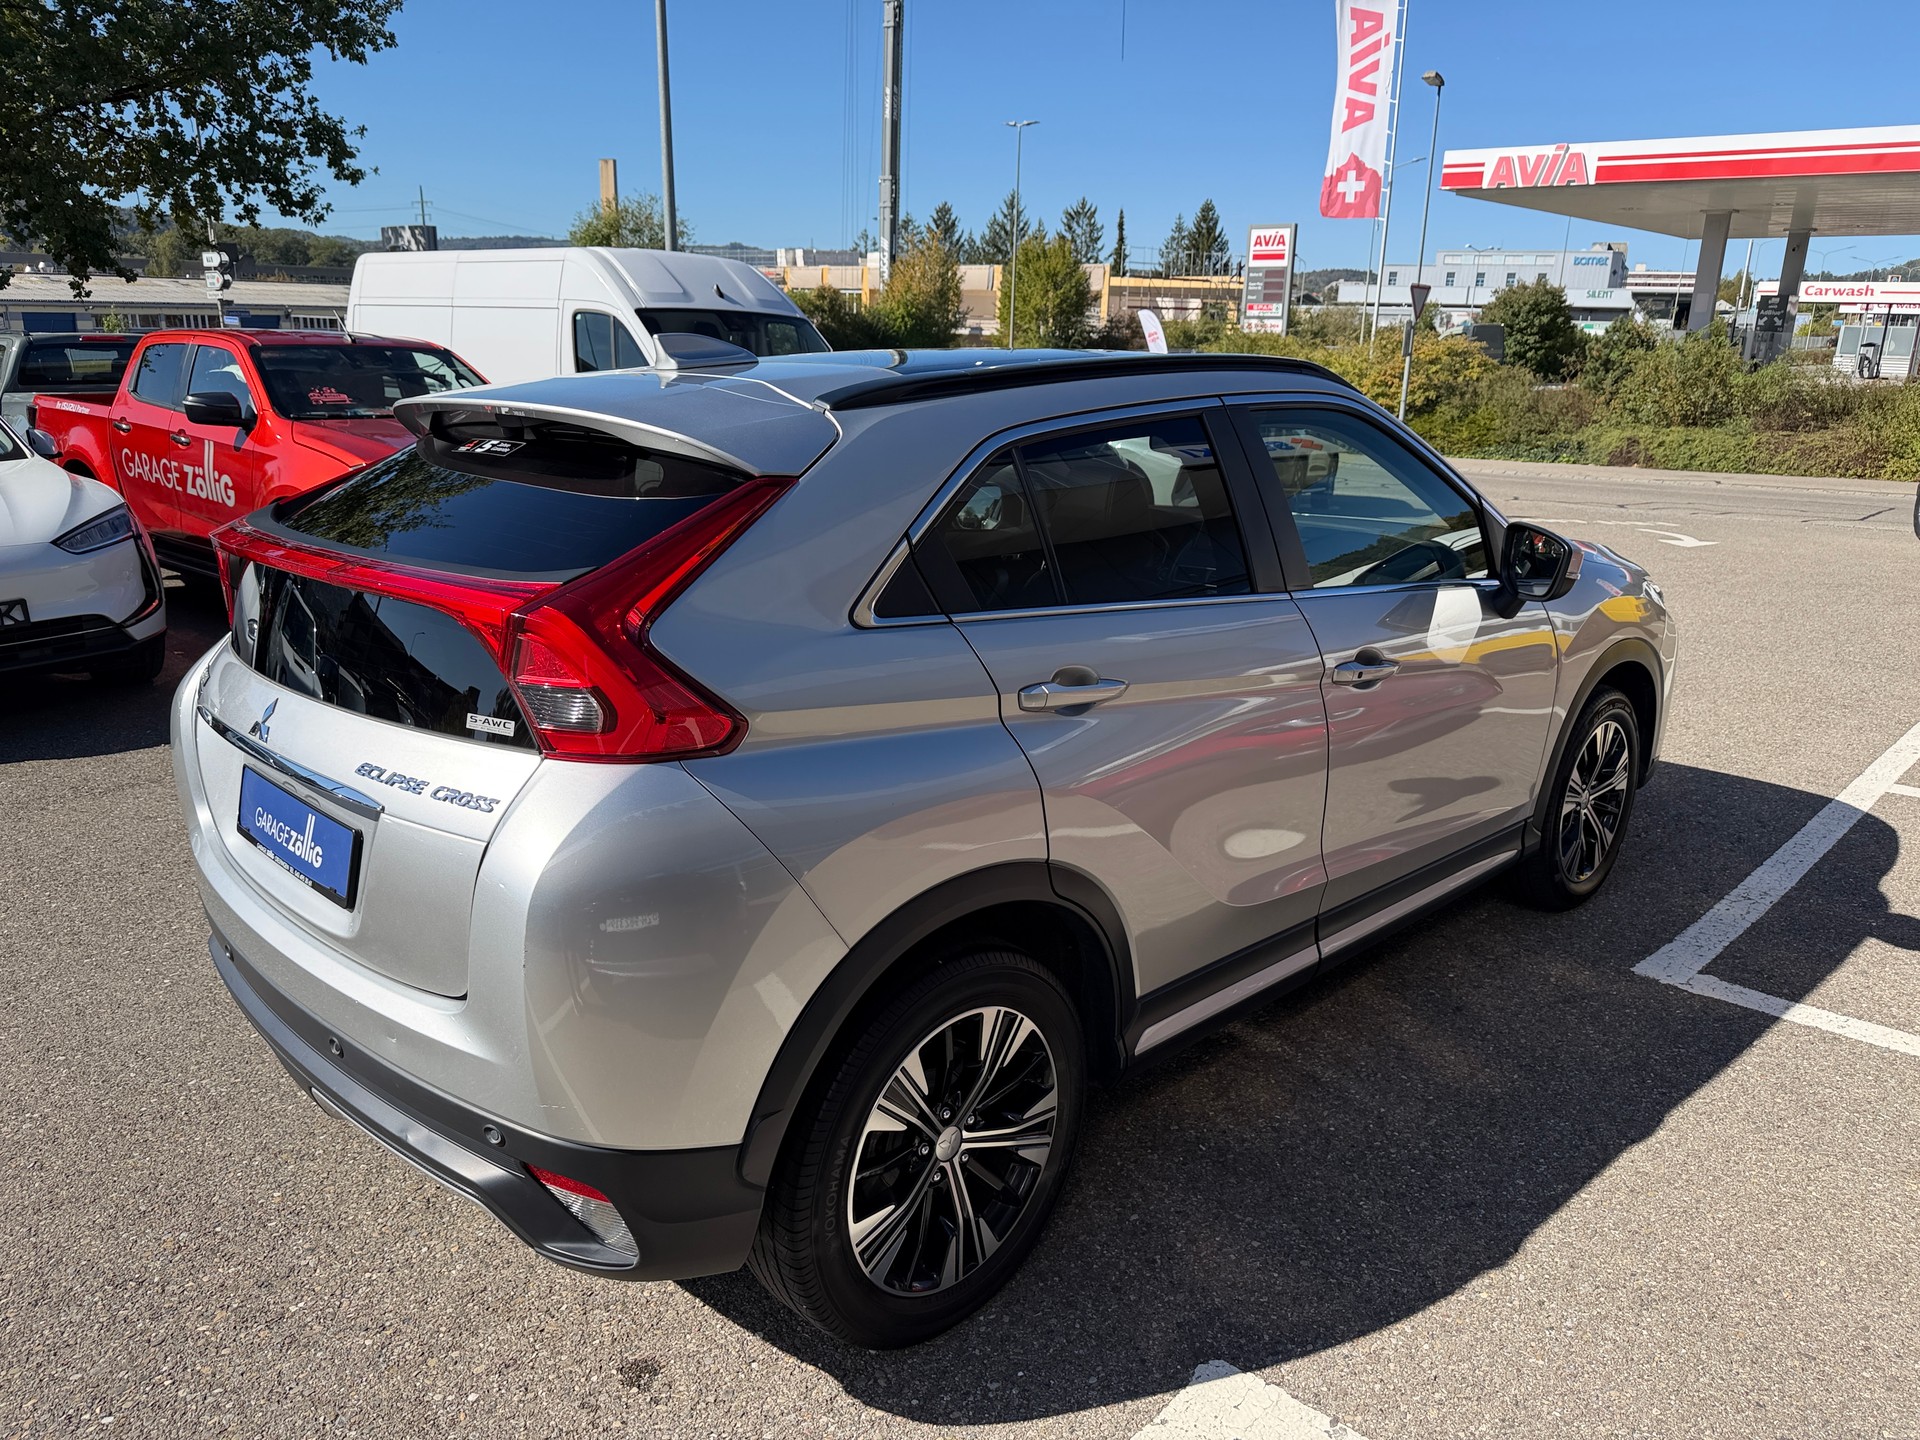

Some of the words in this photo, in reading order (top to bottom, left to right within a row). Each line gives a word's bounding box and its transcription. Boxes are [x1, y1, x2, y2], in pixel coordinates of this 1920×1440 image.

[1586, 289, 1614, 299] SILENT
[1804, 285, 1875, 297] Carwash
[122, 447, 183, 492] GARAGE
[469, 714, 512, 730] S-AWC
[354, 762, 430, 795] ECLIPSE
[430, 786, 501, 813] CROSS
[255, 806, 291, 848] GARAGE
